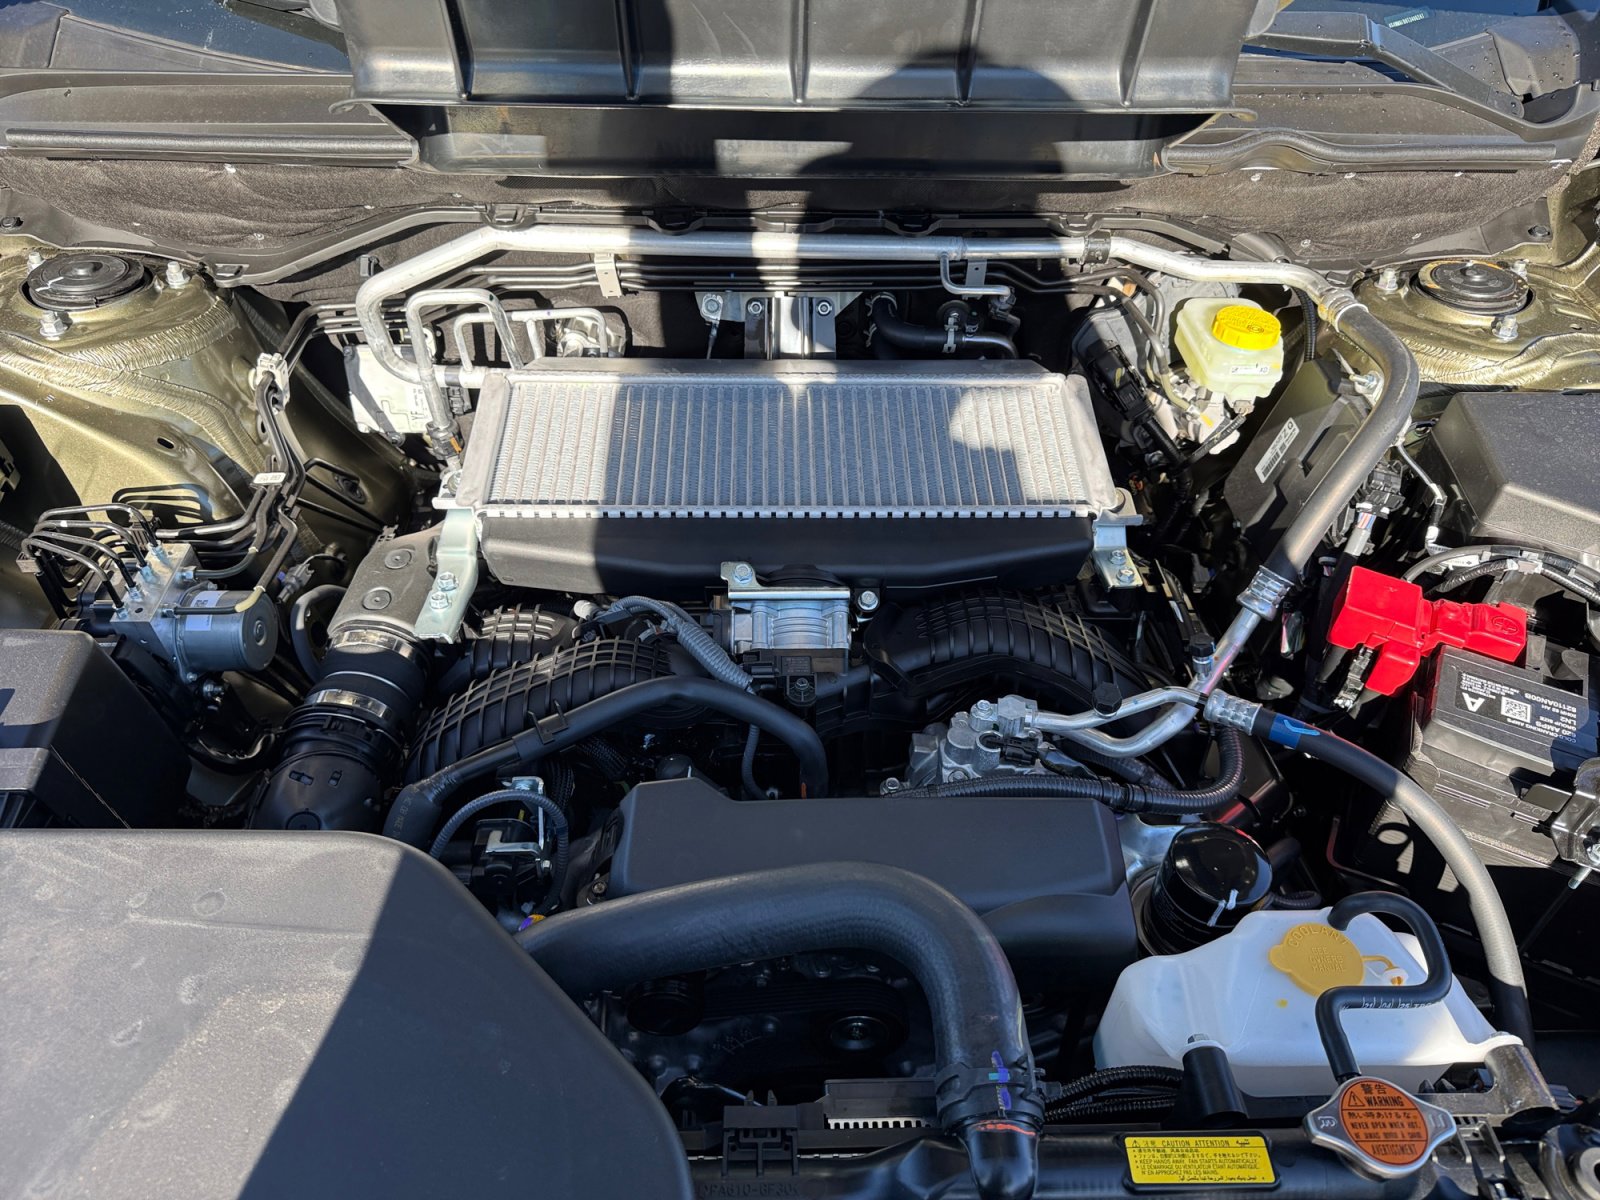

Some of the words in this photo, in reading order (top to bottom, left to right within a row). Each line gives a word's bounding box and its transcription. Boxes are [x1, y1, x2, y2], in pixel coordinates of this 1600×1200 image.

[1461, 692, 1485, 712] A
[1507, 718, 1524, 727] AMPS
[1536, 720, 1560, 732] AMPS
[1555, 721, 1576, 731] GROUP
[1560, 716, 1576, 726] LN2
[1288, 926, 1348, 948] COOLANT
[1360, 1084, 1387, 1094] 警告
[1365, 1096, 1404, 1106] WARNING
